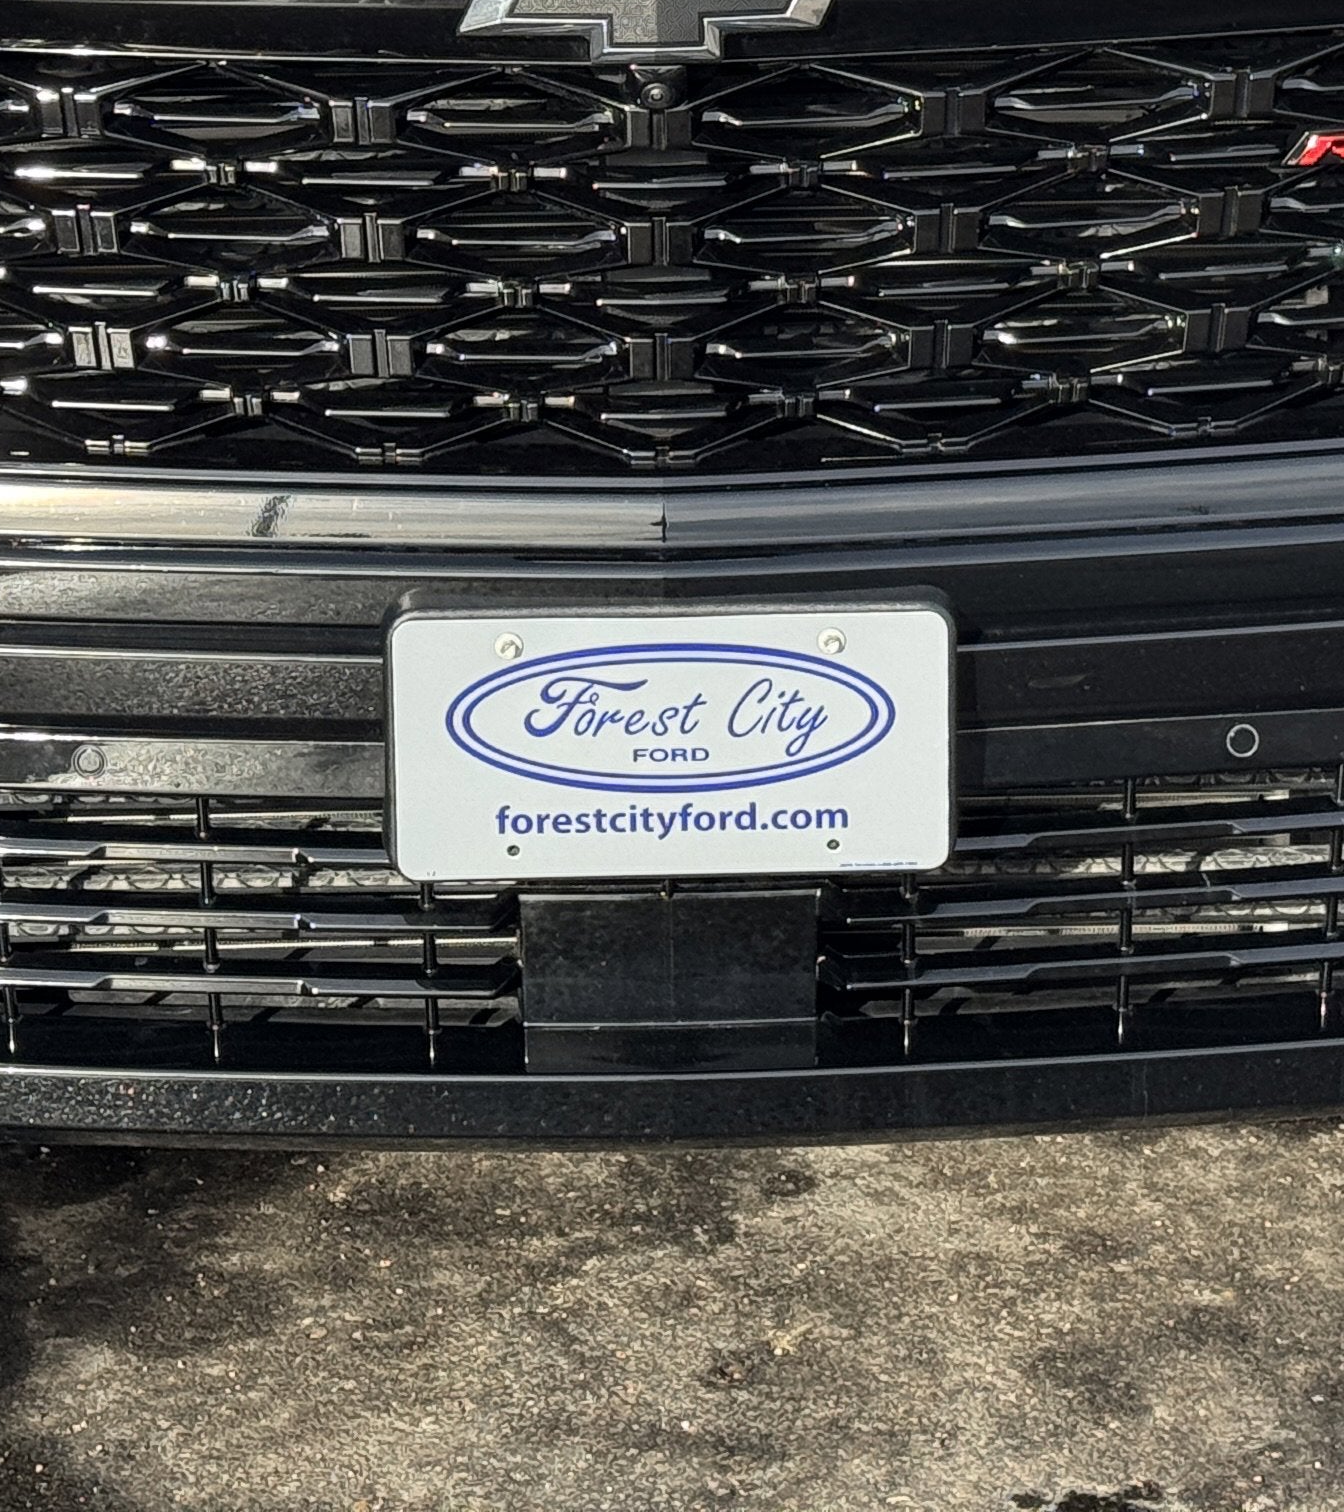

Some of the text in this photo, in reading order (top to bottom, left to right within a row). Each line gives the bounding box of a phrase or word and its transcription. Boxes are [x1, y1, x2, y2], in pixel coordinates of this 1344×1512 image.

[523, 676, 828, 758] Forest City
[632, 747, 710, 763] FORD
[495, 802, 849, 841] forestcityford.com
